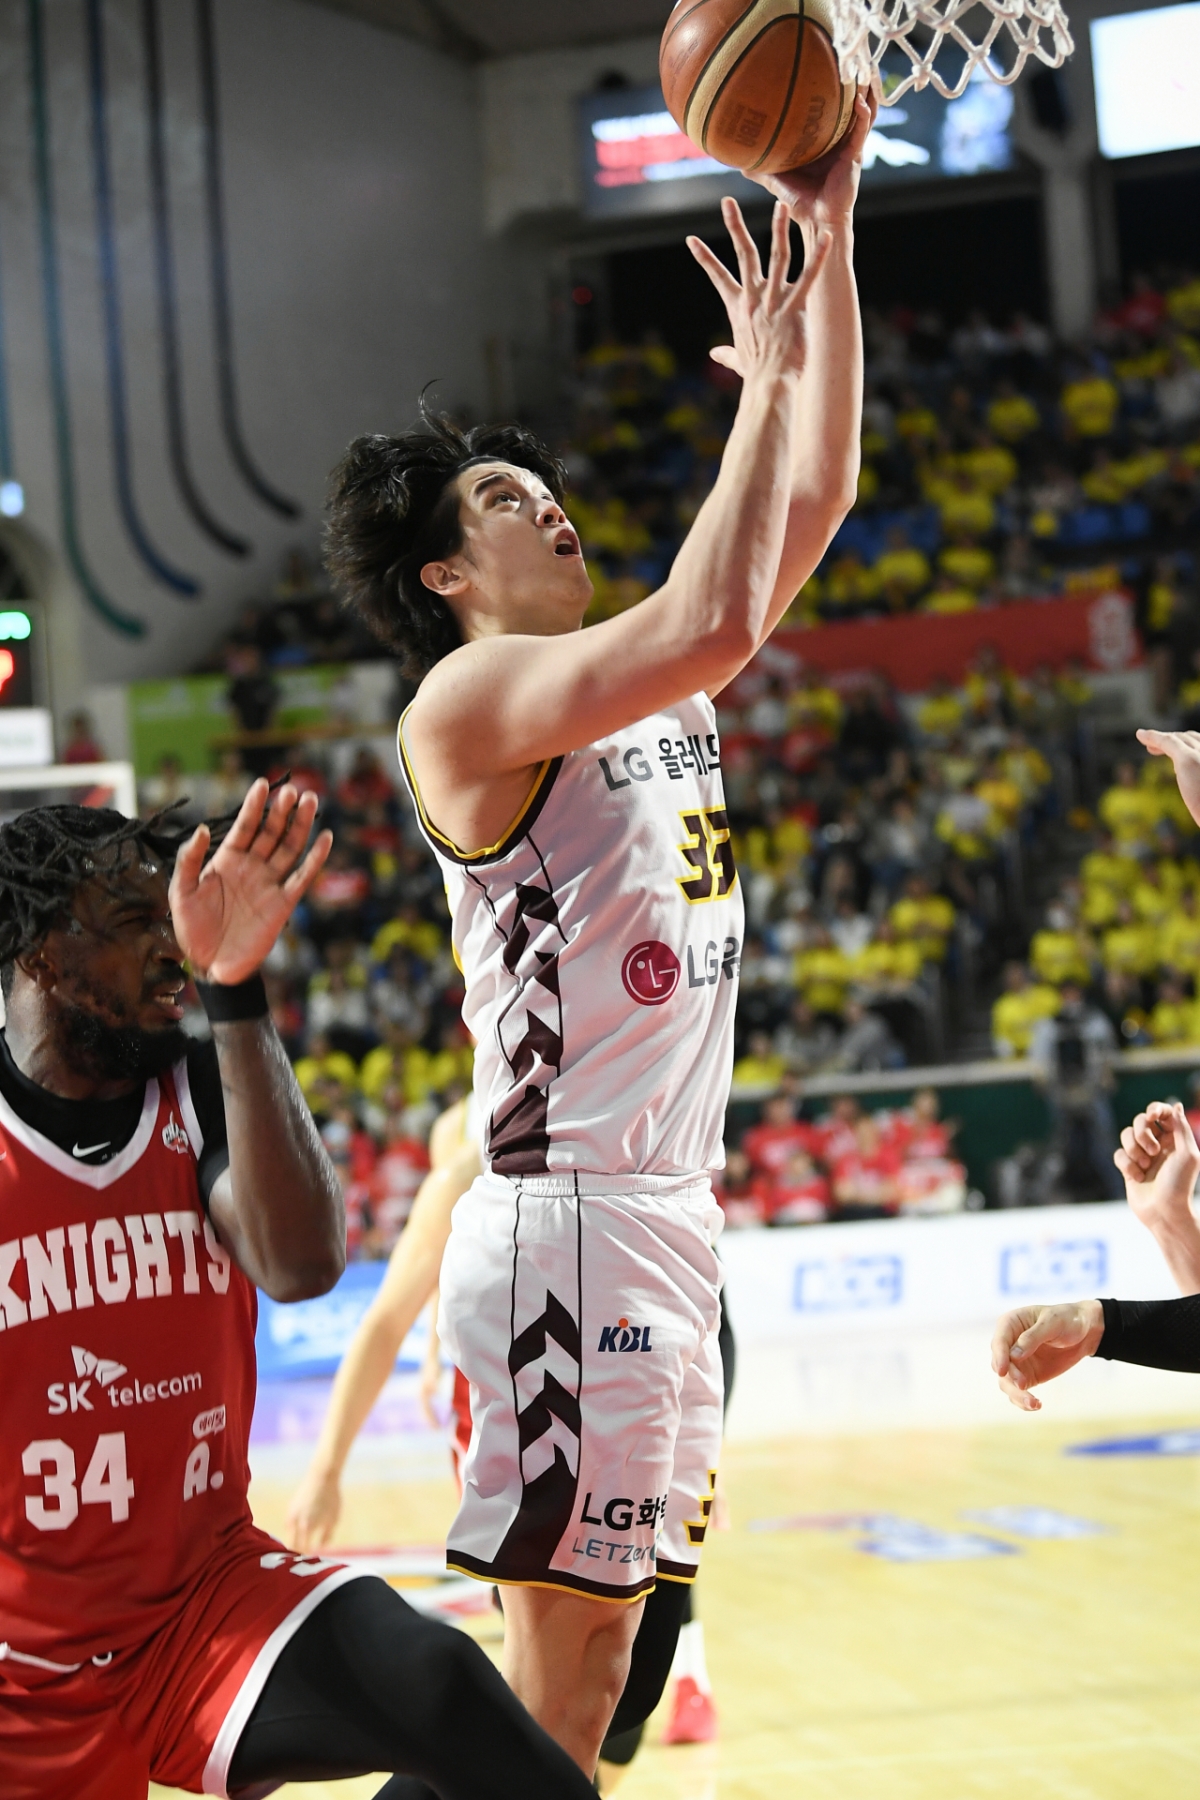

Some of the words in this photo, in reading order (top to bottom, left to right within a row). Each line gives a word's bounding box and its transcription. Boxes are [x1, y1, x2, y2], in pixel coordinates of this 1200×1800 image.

[598, 746, 654, 791] LG
[0, 1211, 231, 1331] KNIGHTS
[598, 1325, 652, 1352] KBL
[47, 1380, 95, 1416] SK
[107, 1371, 203, 1409] telecom
[21, 1431, 135, 1531] 34
